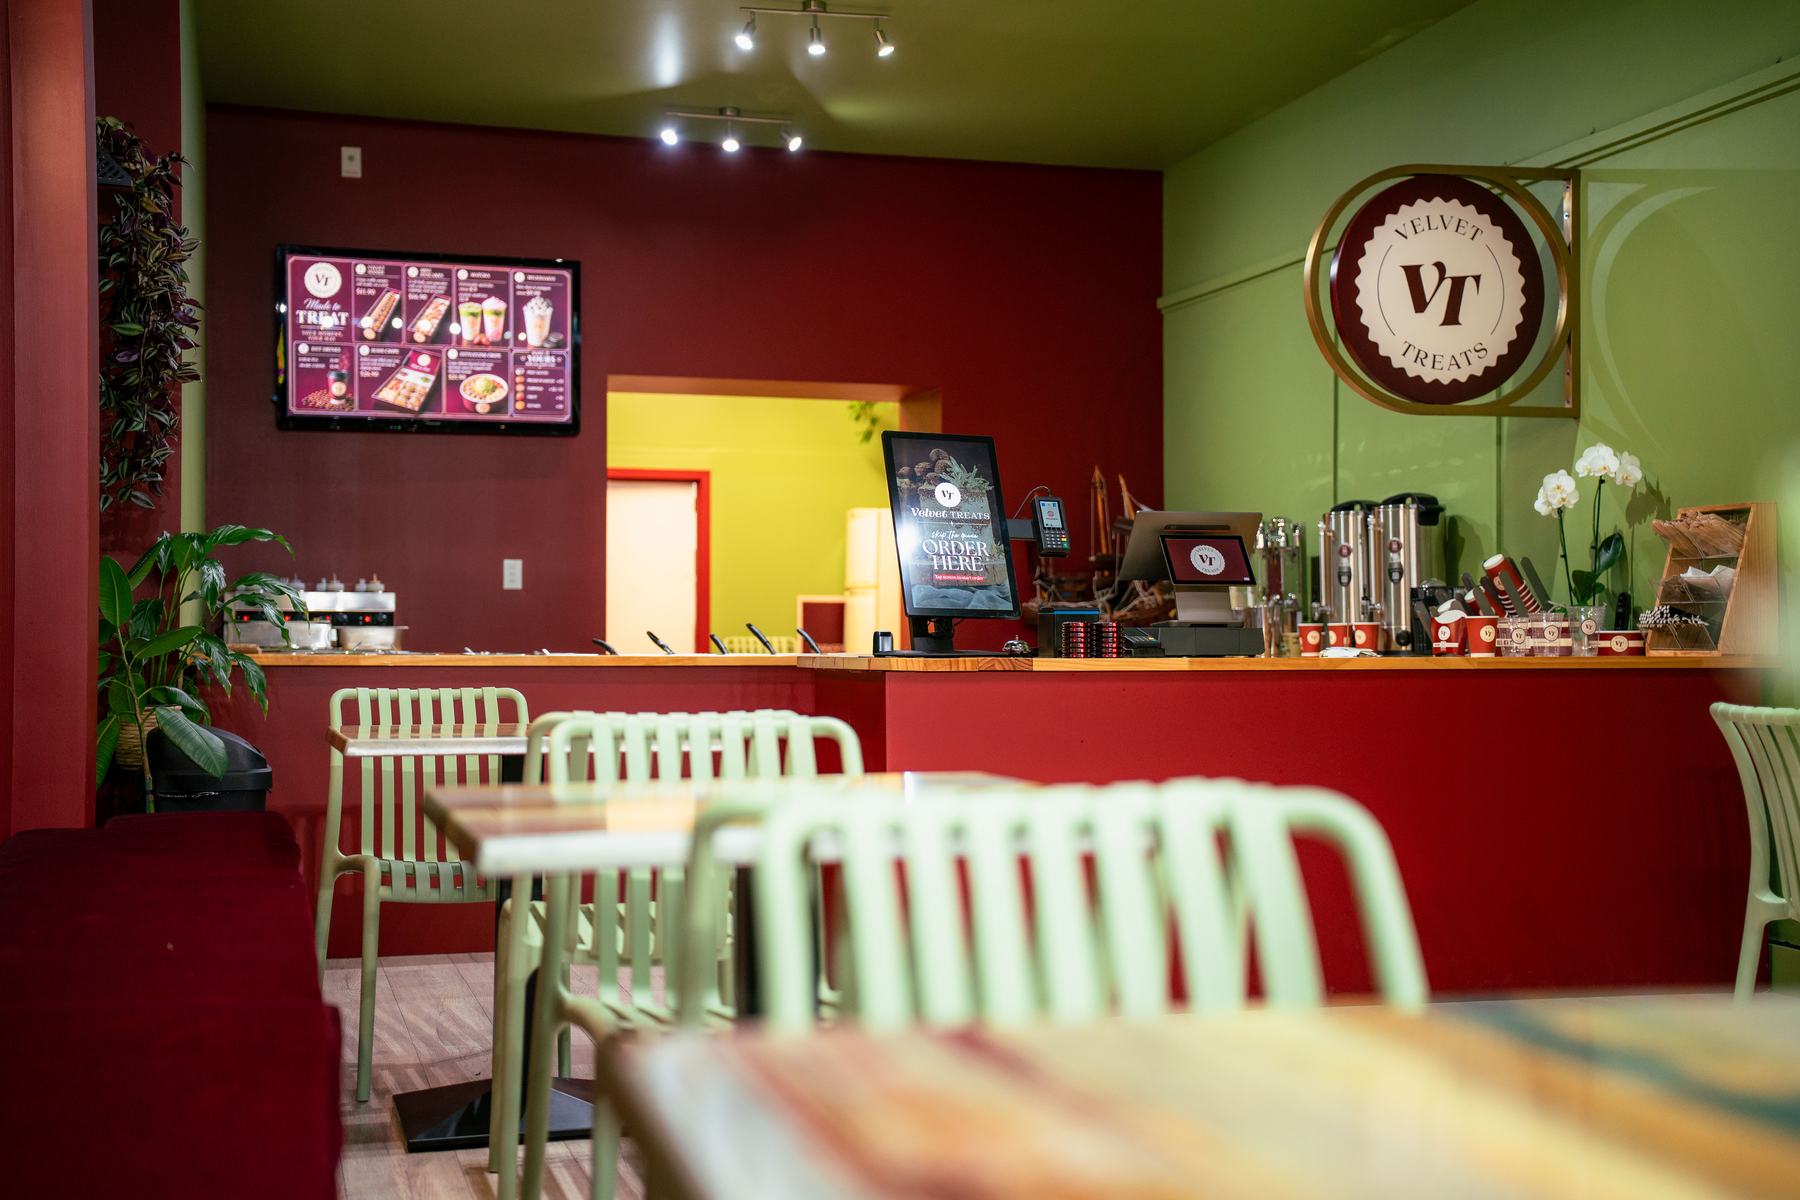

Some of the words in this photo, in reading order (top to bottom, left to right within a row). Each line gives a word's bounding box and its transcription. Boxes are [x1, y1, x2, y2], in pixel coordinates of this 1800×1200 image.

[1394, 214, 1483, 242] VELVET
[1400, 261, 1482, 327] VT
[1401, 341, 1488, 371] TREATS
[911, 508, 948, 518] Velvet
[949, 512, 991, 520] TREATS
[922, 539, 990, 557] ORDER
[932, 555, 983, 572] HERE
[1199, 553, 1216, 566] VT
